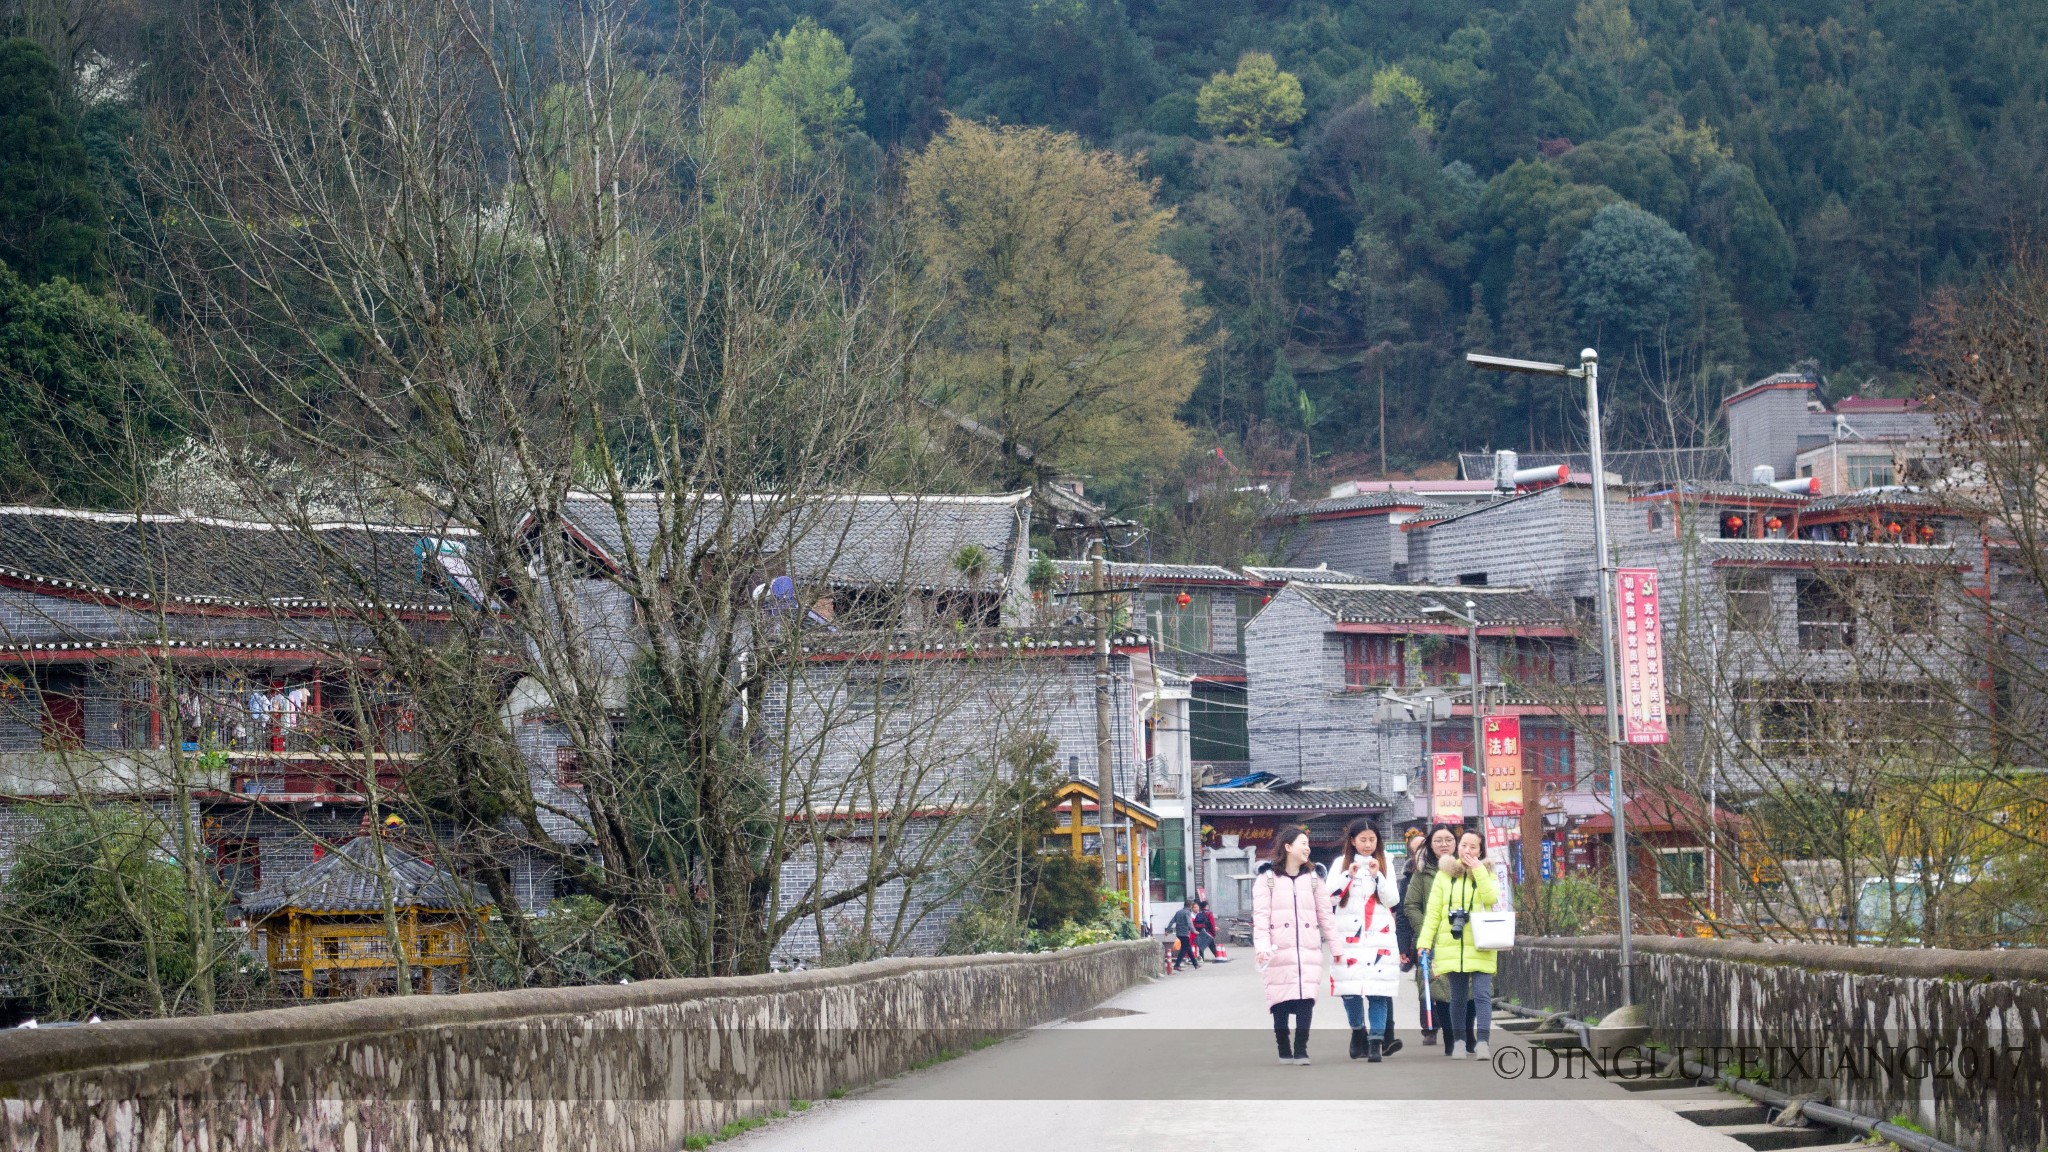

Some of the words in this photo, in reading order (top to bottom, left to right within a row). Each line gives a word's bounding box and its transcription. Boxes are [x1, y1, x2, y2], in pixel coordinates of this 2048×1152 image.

[1624, 576, 1642, 720] 切实保障党员民主权利
[1488, 737, 1518, 755] 法制
[1436, 768, 1460, 782] 爱国
